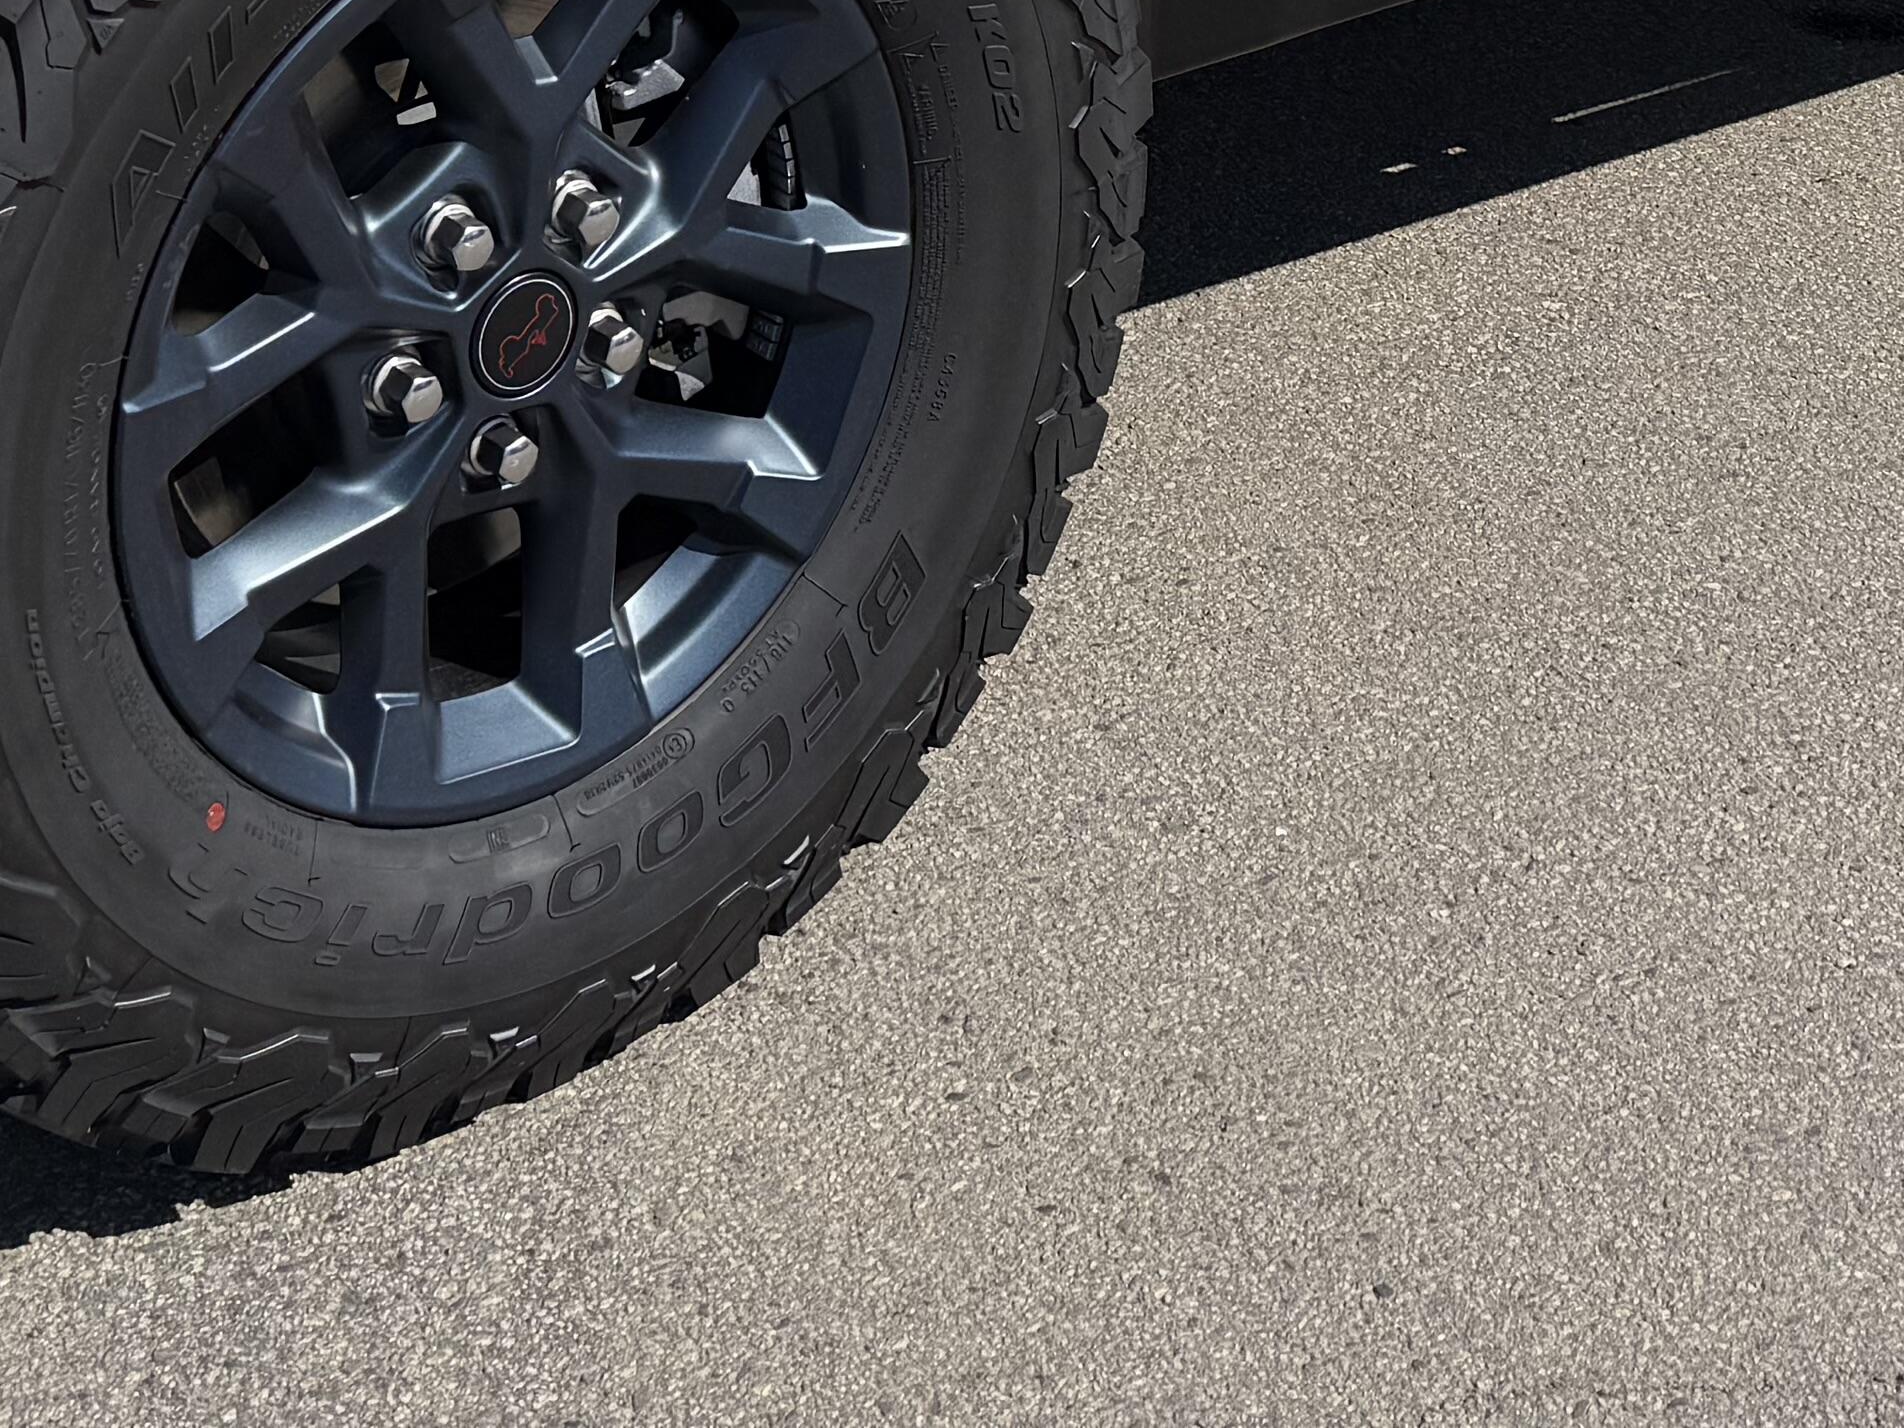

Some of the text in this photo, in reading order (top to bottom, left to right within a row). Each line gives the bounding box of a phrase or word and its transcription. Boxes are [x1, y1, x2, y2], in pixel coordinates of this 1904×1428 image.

[962, 2, 1028, 134] KO2
[27, 608, 145, 868] Baja Champion
